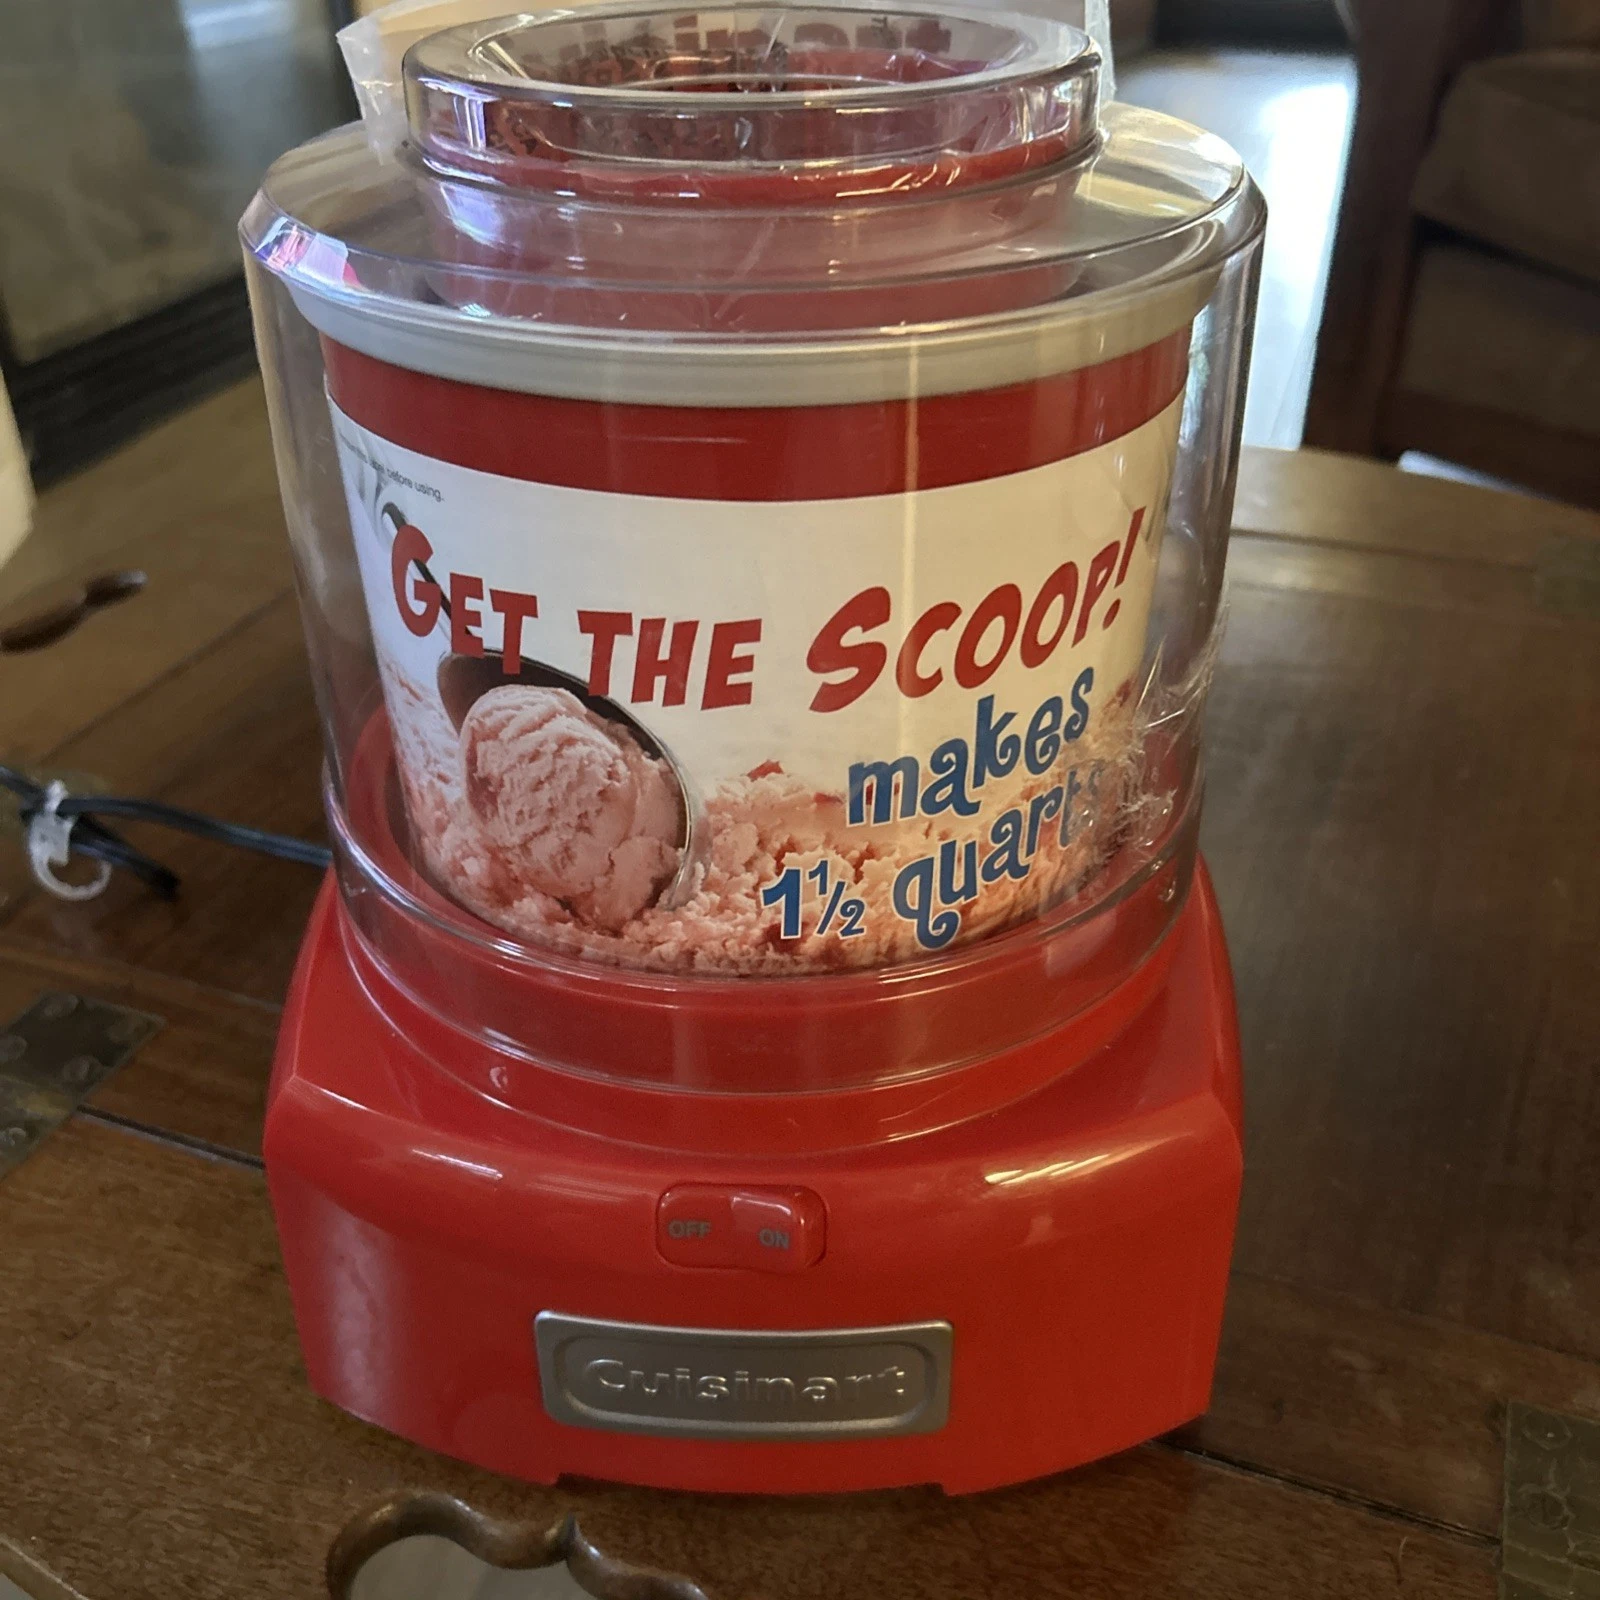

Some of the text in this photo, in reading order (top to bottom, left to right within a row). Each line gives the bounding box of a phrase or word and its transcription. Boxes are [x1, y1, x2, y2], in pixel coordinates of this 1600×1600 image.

[415, 483, 446, 503] using.
[391, 506, 1146, 713] GET THE SCOOP!
[847, 667, 1095, 828] makes
[668, 1219, 790, 1250] OFF ON
[587, 1358, 906, 1402] Cuisinart
